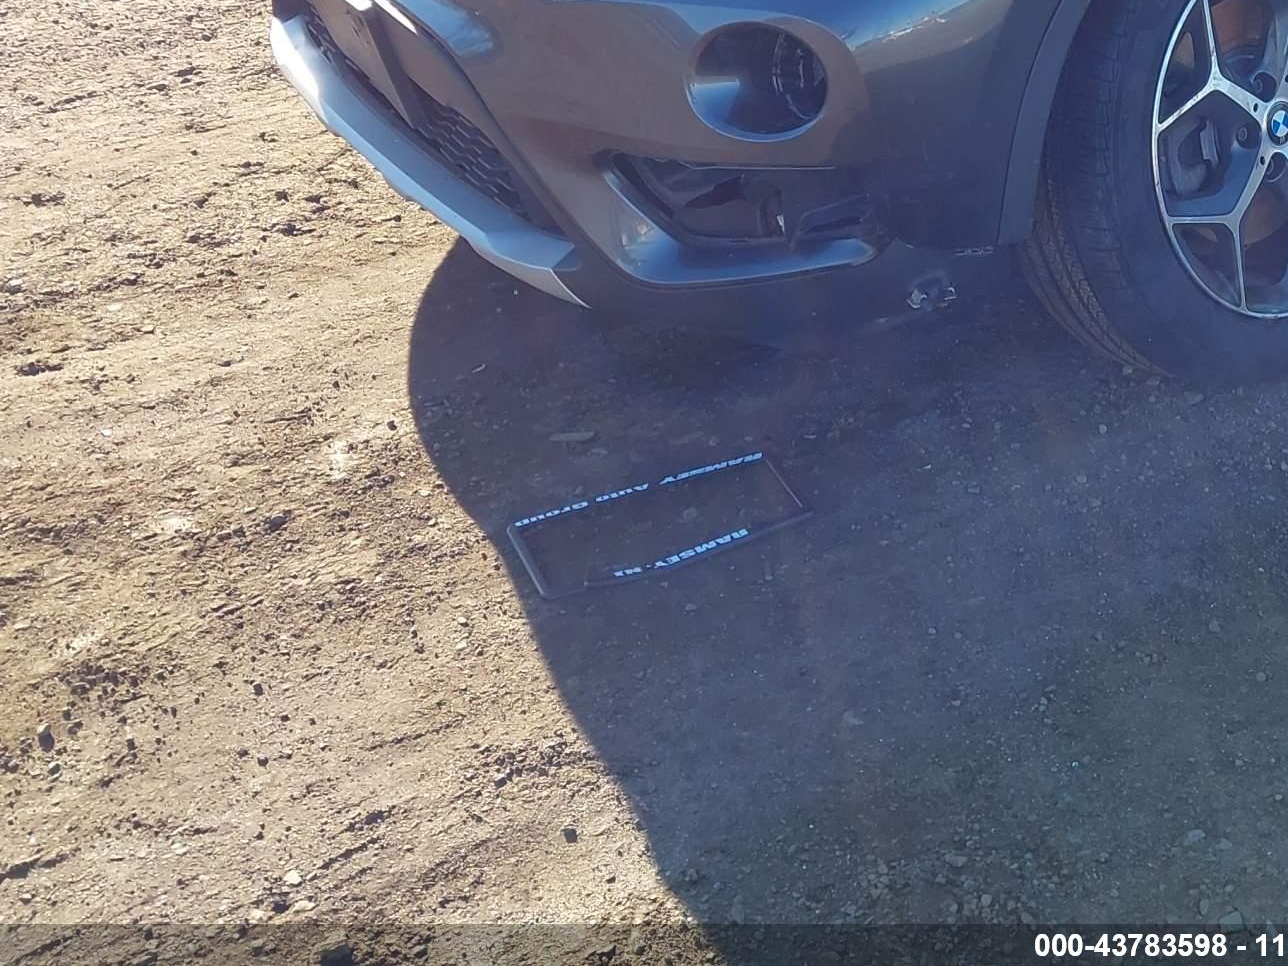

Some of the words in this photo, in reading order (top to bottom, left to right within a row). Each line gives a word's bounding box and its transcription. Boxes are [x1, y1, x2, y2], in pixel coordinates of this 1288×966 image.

[595, 482, 649, 502] Auto
[513, 501, 589, 527] Group
[654, 528, 749, 569] RAMSEY
